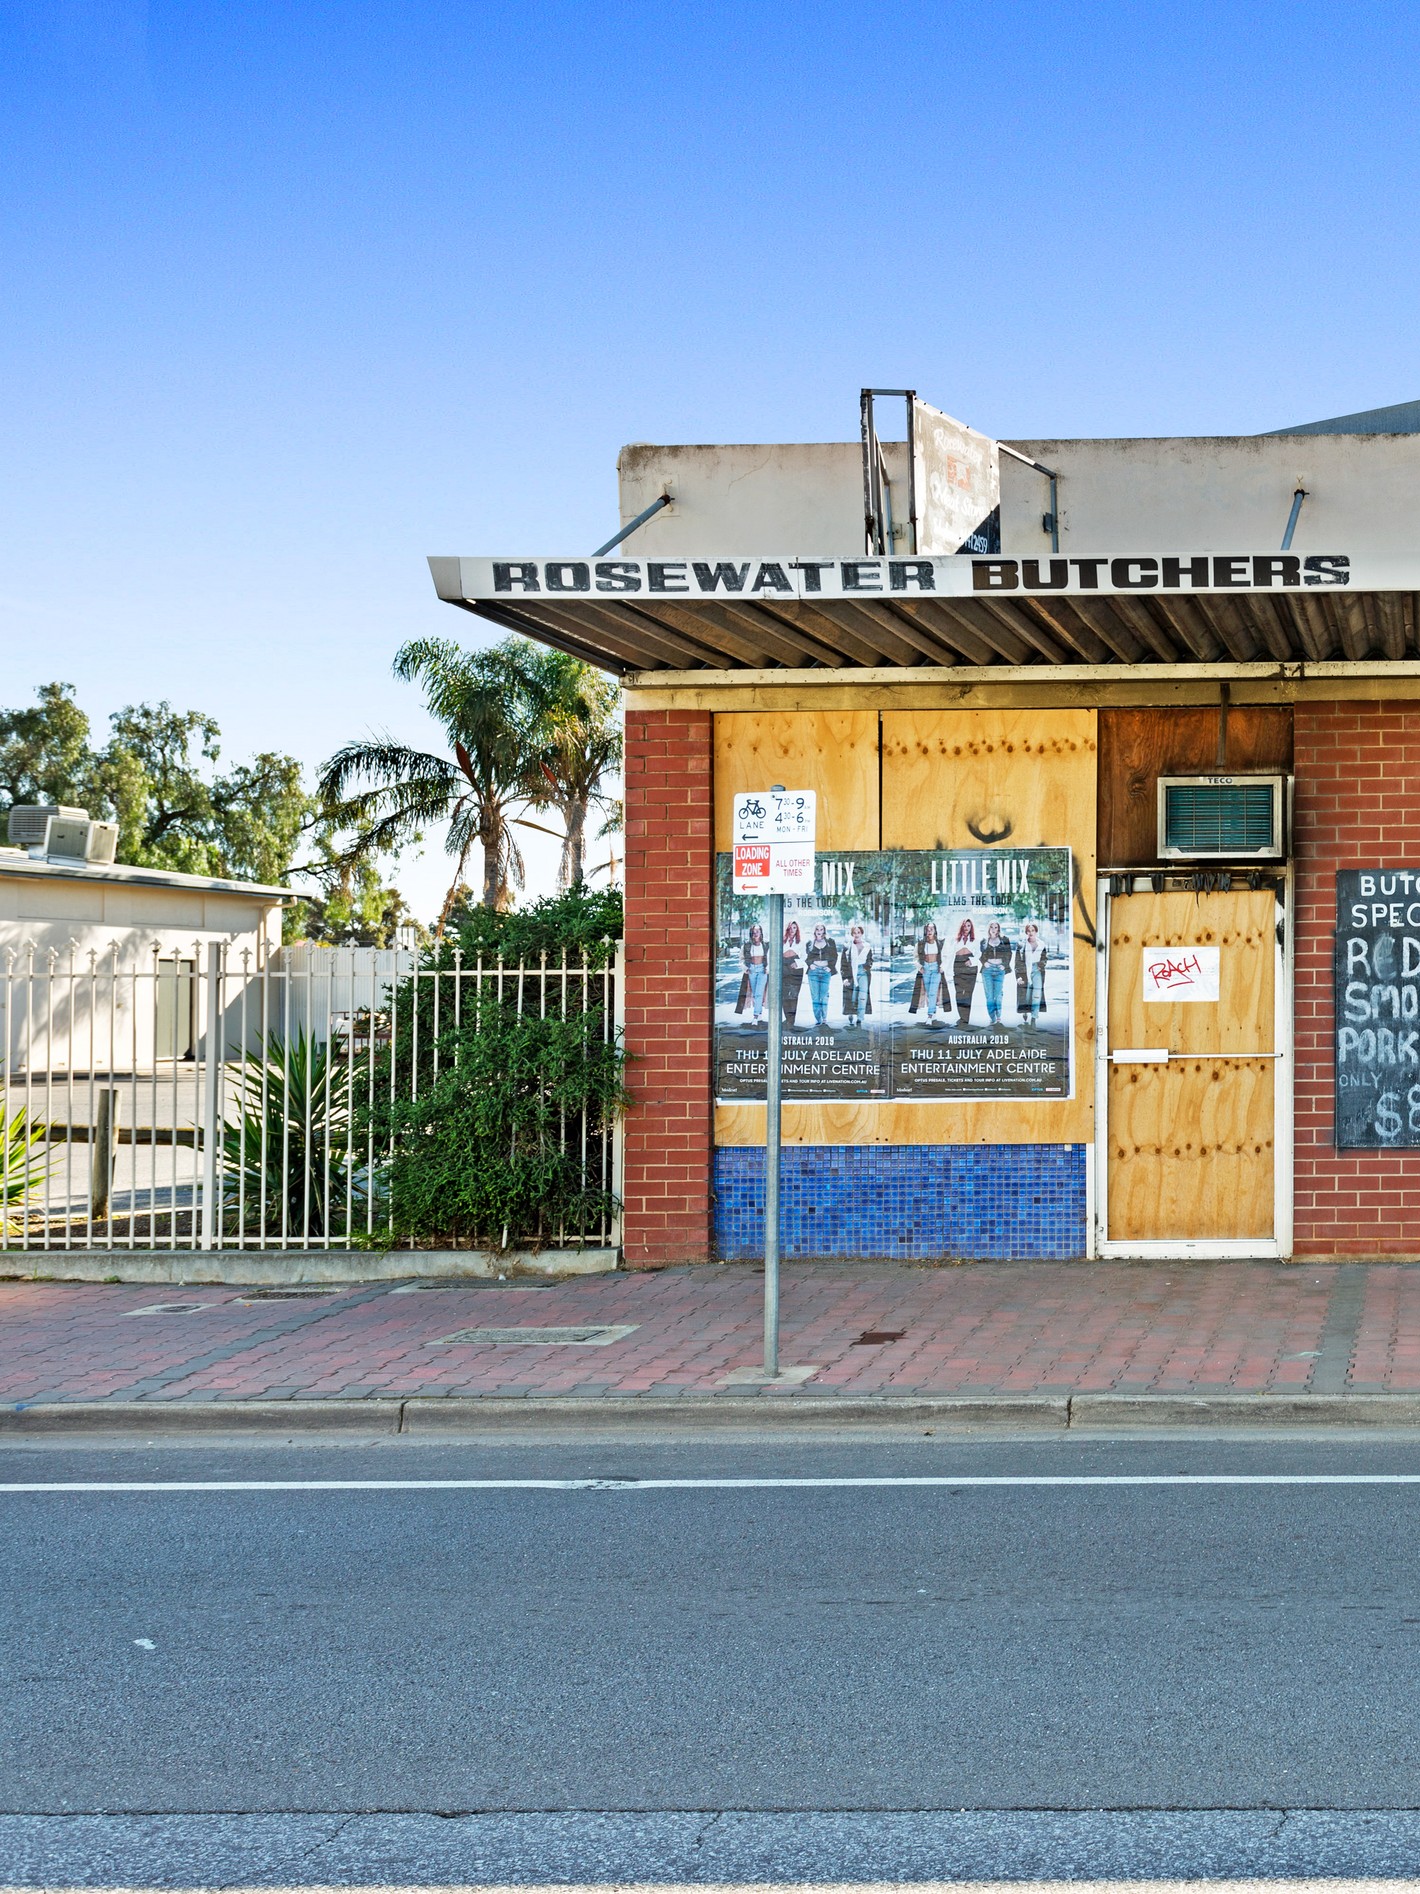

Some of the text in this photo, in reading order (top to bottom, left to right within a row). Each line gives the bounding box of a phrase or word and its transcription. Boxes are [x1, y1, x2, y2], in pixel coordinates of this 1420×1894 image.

[492, 555, 1351, 593] ROSEWATER BUTCHERS
[740, 821, 764, 830] LANE
[736, 847, 770, 860] LOADING
[788, 859, 810, 867] OTHER
[742, 863, 762, 876] ZONE
[784, 869, 802, 877] TIMES
[822, 862, 856, 896] MIX
[931, 859, 1030, 895] LITTLE MIX
[796, 898, 812, 908] THE
[816, 897, 838, 908] TOUR
[948, 896, 1012, 906] LM5 THE TOUR
[1148, 954, 1202, 988] ROACH
[782, 1036, 834, 1046] STRALIA 2019
[948, 1035, 1009, 1045] AUSTRALIA 2019
[1338, 1026, 1420, 1064] PORK
[735, 1050, 760, 1060] THU
[812, 1050, 872, 1061] ADELAIDE
[910, 1049, 1047, 1060] THU 11 JULY ADELAIDE
[832, 1064, 880, 1076] CENTRE
[901, 1062, 1056, 1074] ENTERTAINMENT CENTRE
[1338, 1072, 1382, 1089] ONLY
